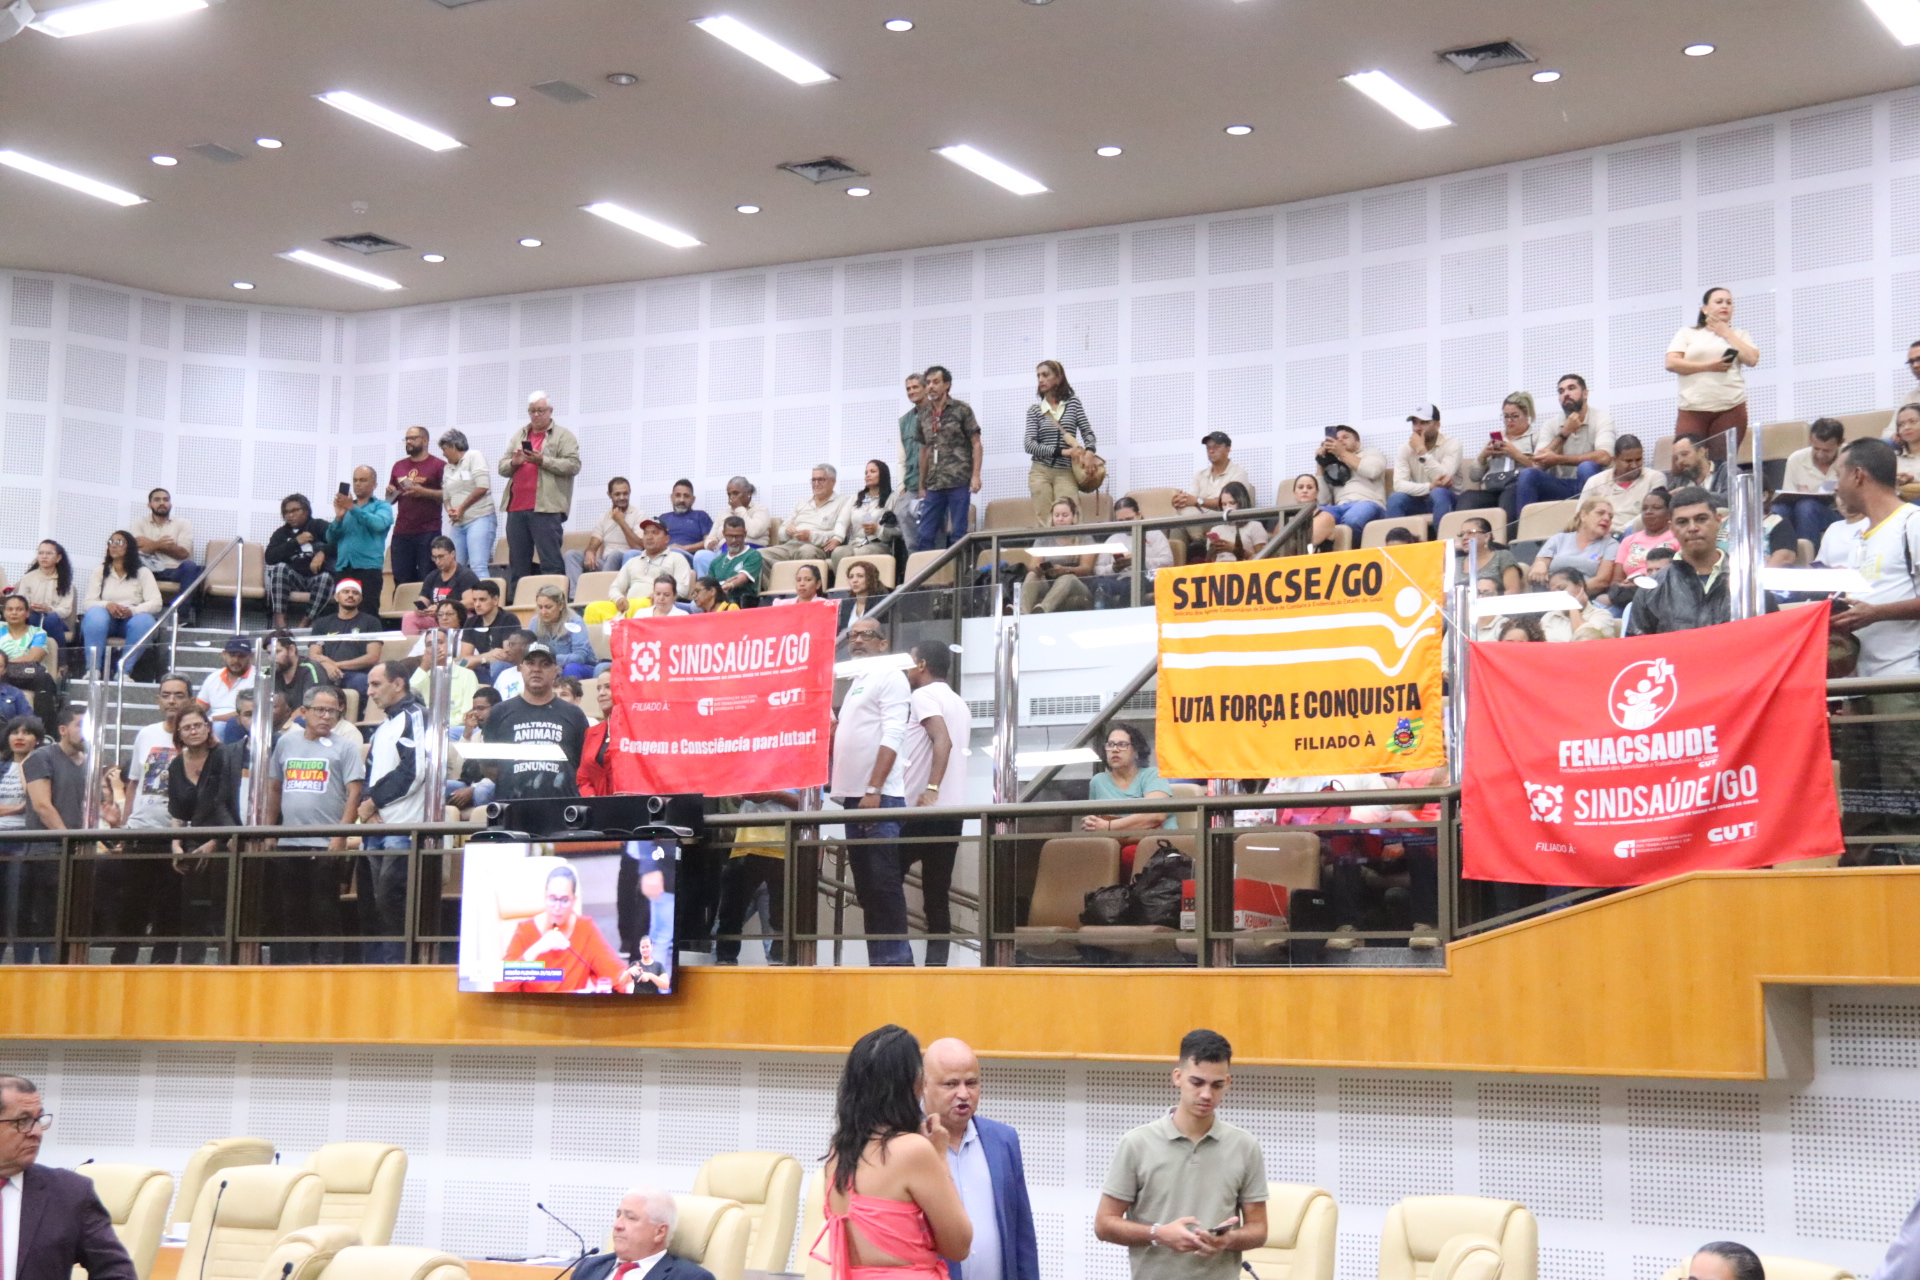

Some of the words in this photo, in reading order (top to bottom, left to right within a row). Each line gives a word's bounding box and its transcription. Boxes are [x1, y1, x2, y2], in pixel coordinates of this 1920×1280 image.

[1172, 561, 1383, 610] SINDACSE/GO
[668, 632, 811, 675] SINDSAÚDE/GO
[768, 687, 802, 706] CUT
[631, 702, 661, 711] FILIADO
[1172, 695, 1215, 723] LUTA
[1220, 693, 1286, 728] FORÇA
[1290, 692, 1300, 720] E
[1303, 682, 1422, 719] CONQUISTA
[513, 721, 563, 731] MALTRATAR
[514, 729, 563, 743] ANIMAIS
[671, 741, 679, 754] e
[680, 736, 751, 754] Consciência
[752, 735, 779, 752] para
[779, 728, 817, 747] Lutar!
[1294, 734, 1360, 751] FILIADO
[1364, 730, 1376, 747] À
[1559, 725, 1719, 767] FENACSAUDE
[288, 761, 324, 770] SINTEGO
[513, 761, 560, 774] DENUNCIE
[1655, 758, 1693, 767] Trabalhadores
[1698, 759, 1718, 768] CUT
[300, 770, 324, 780] LUTA
[1573, 765, 1758, 819] SINDSAÚDE/GO
[1707, 821, 1754, 843] CUT
[1535, 842, 1567, 853] FILIADO
